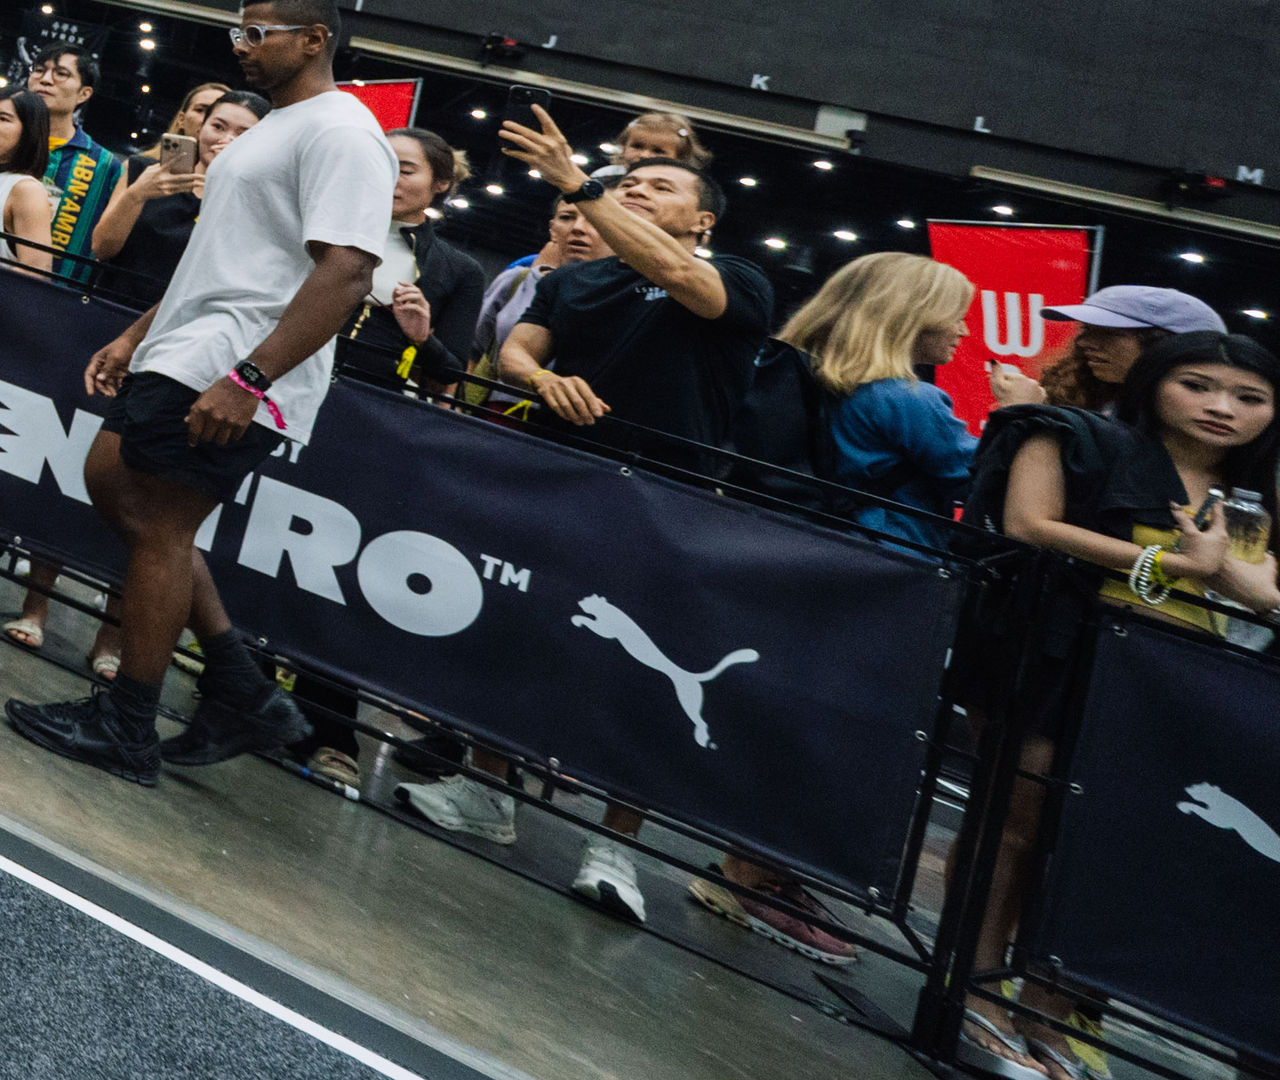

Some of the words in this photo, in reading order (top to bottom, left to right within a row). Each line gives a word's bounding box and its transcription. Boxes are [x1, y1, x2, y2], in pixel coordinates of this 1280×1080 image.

[541, 35, 558, 49] J
[750, 74, 770, 91] K
[973, 116, 991, 133] L
[1236, 165, 1265, 185] M
